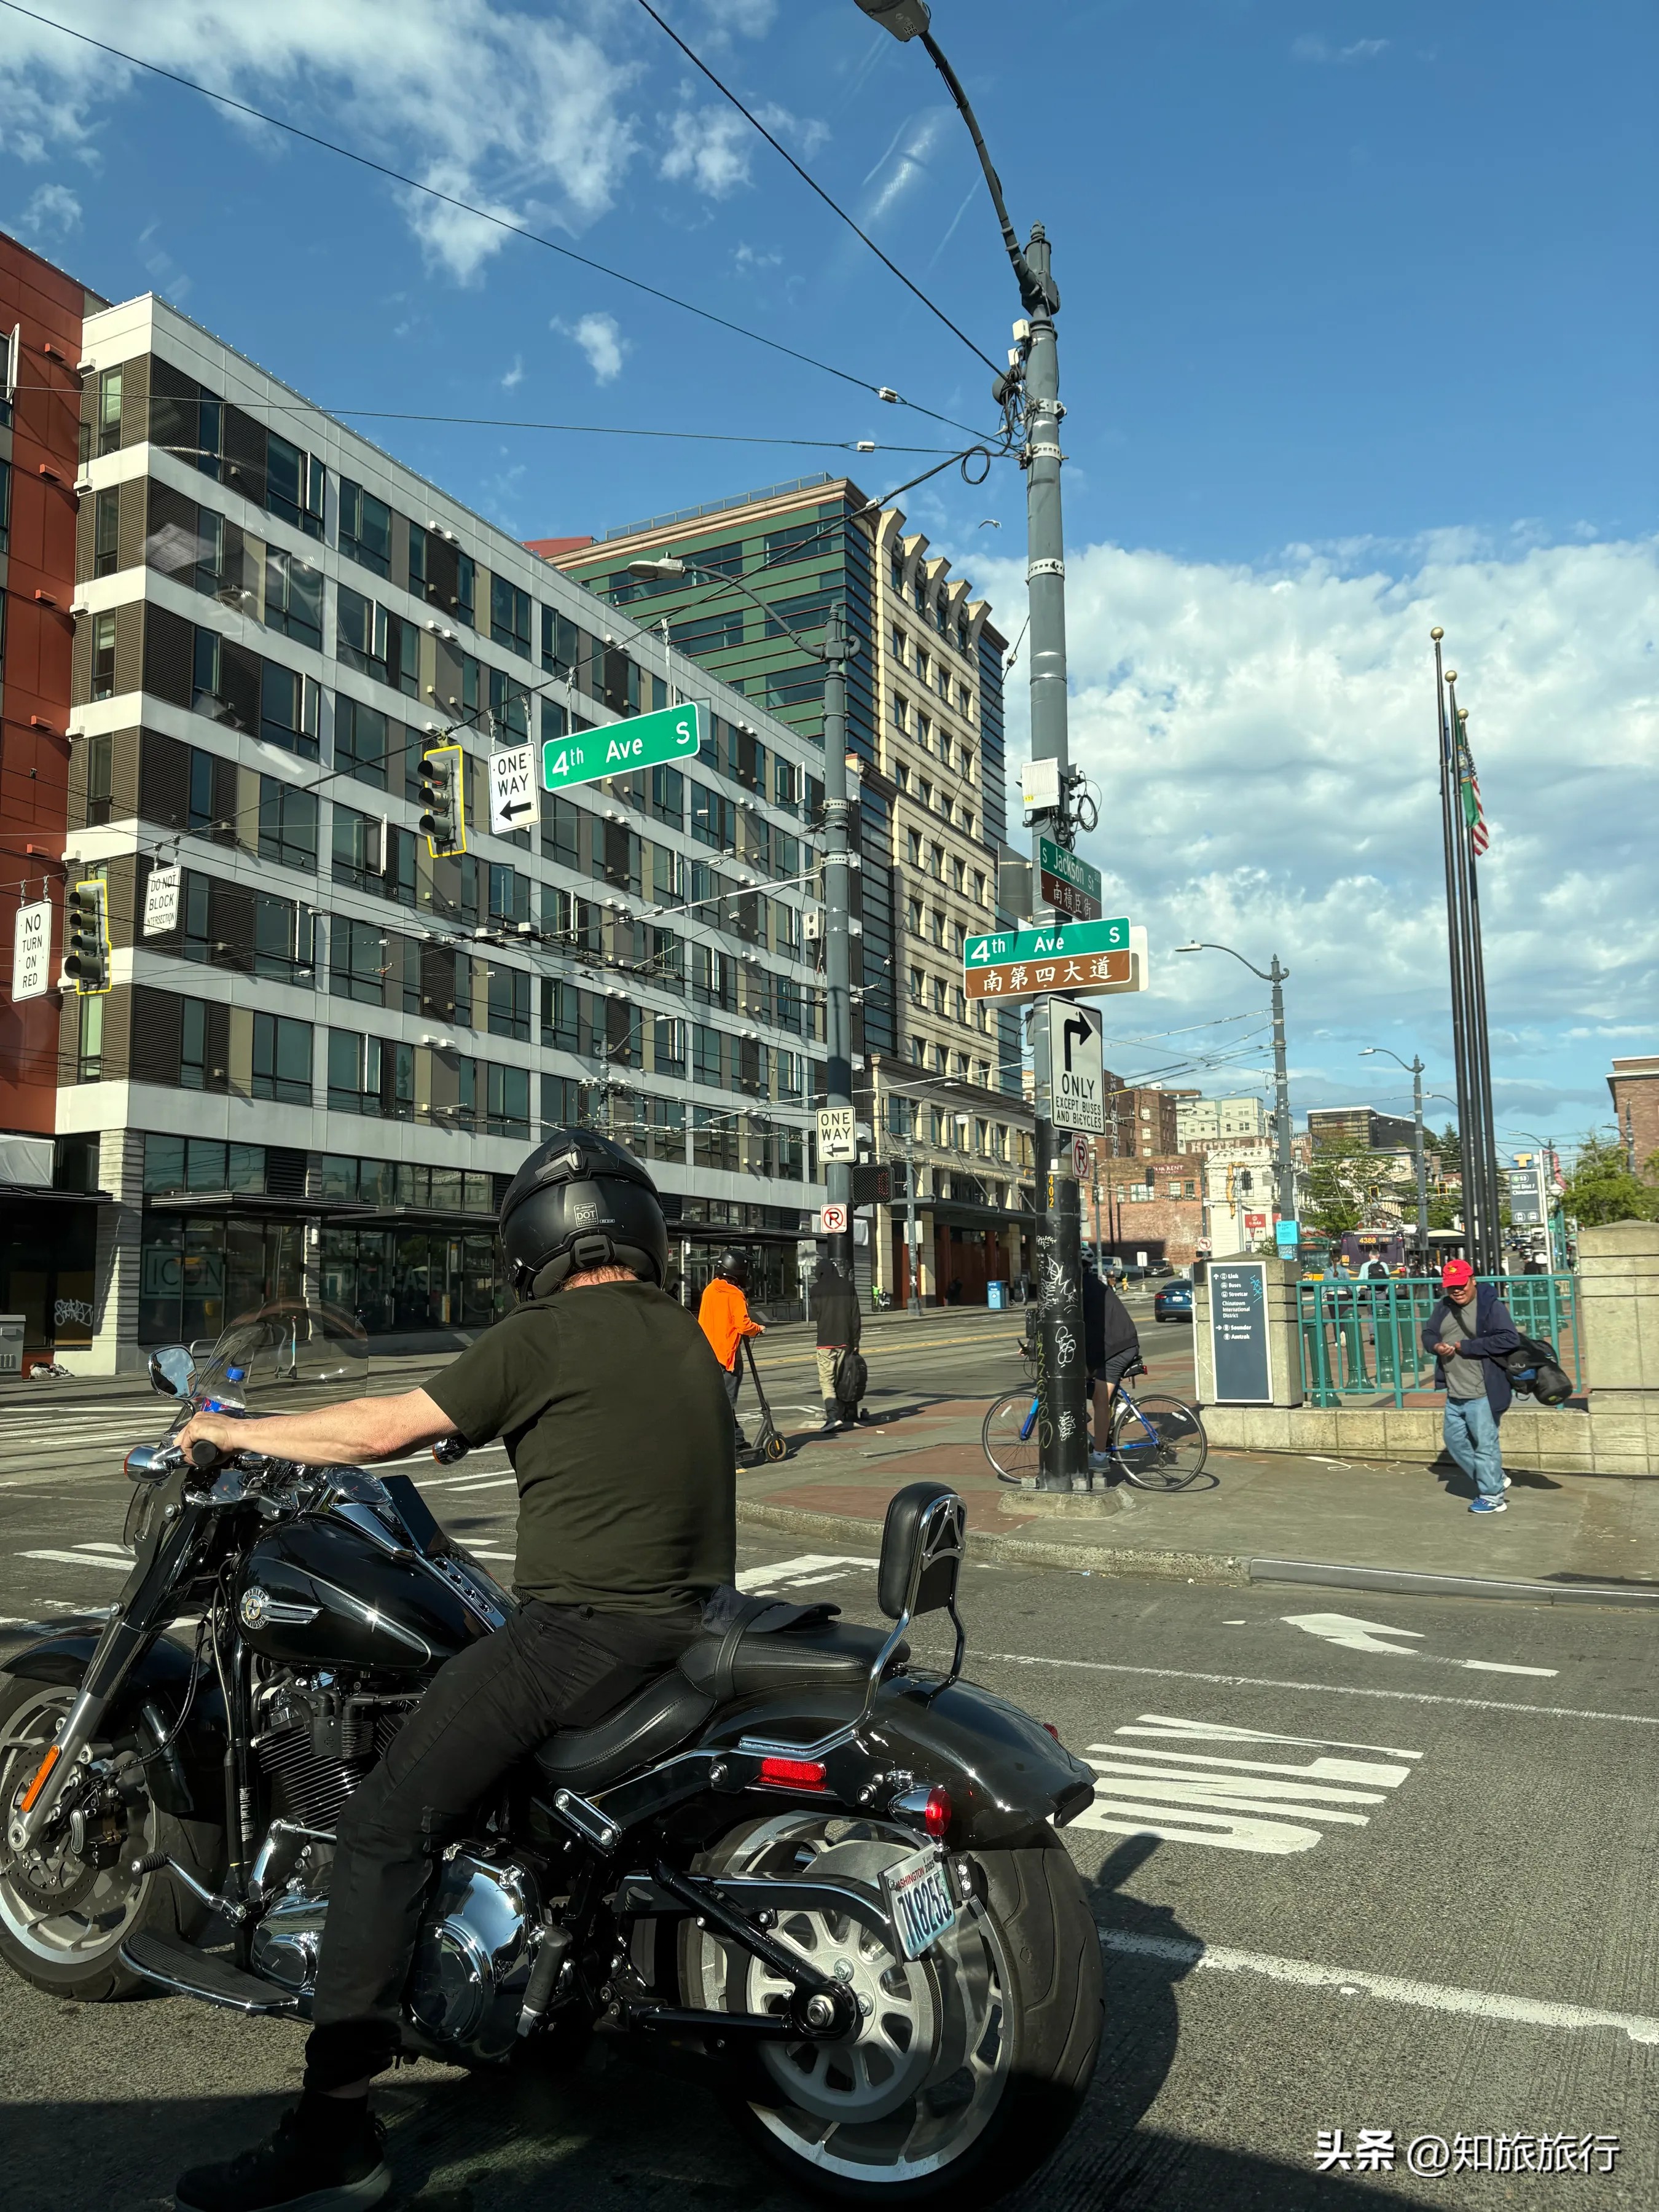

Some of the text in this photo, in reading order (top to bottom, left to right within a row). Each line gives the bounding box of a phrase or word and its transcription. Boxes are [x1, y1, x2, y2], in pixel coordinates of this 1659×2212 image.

[552, 721, 690, 777] 4th Ave S
[498, 753, 527, 776] ONE
[497, 772, 529, 798] WAY
[1042, 847, 1048, 863] S
[1053, 847, 1084, 885] Jackson
[1088, 874, 1094, 892] St
[151, 874, 176, 892] DO NOT
[149, 893, 175, 911] BLOCK
[25, 914, 41, 935] NO
[146, 912, 175, 926] NTERSECTION
[22, 935, 42, 953] TURN
[971, 927, 1121, 963] 4th Ave S
[26, 955, 37, 970] ON
[23, 973, 37, 989] RED
[983, 955, 1113, 992] 南第四大道
[1061, 1073, 1095, 1100] ONLY
[1056, 1096, 1102, 1116] EXCEPT BUSES
[821, 1112, 850, 1126] ONE
[1056, 1110, 1102, 1129] AND BICYCLES
[822, 1127, 851, 1141] WAY
[576, 1210, 595, 1220] DOT
[154, 1258, 222, 1287] ICON
[924, 1859, 935, 1873] 2025
[897, 1872, 951, 1948] 7K8255
